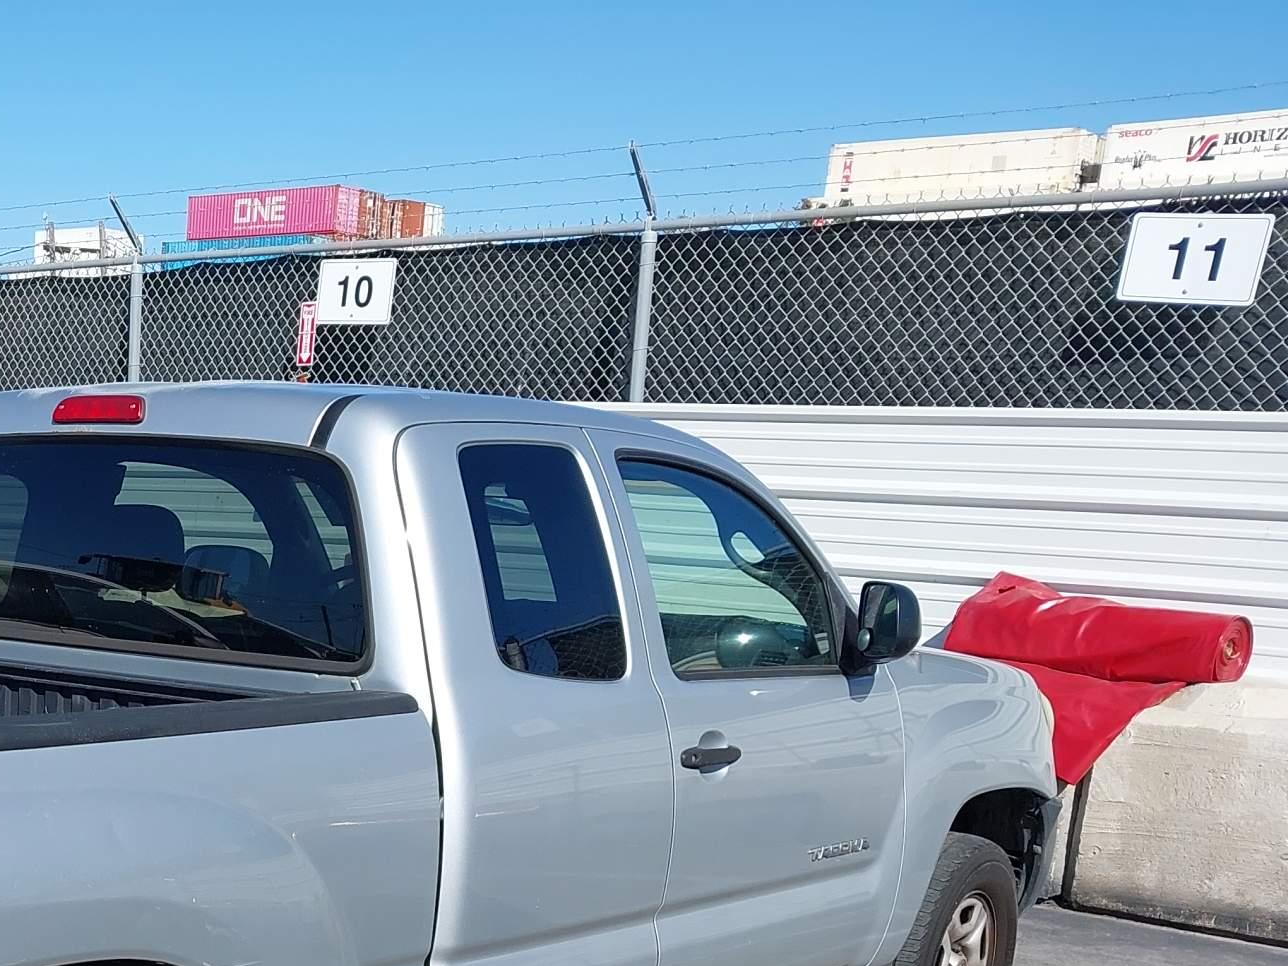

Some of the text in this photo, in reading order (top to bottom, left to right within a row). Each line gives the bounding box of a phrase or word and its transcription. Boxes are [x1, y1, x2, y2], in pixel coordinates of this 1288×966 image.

[1118, 129, 1153, 139] seaco
[233, 195, 286, 224] ONE
[1168, 236, 1227, 281] 11
[338, 275, 373, 308] 10
